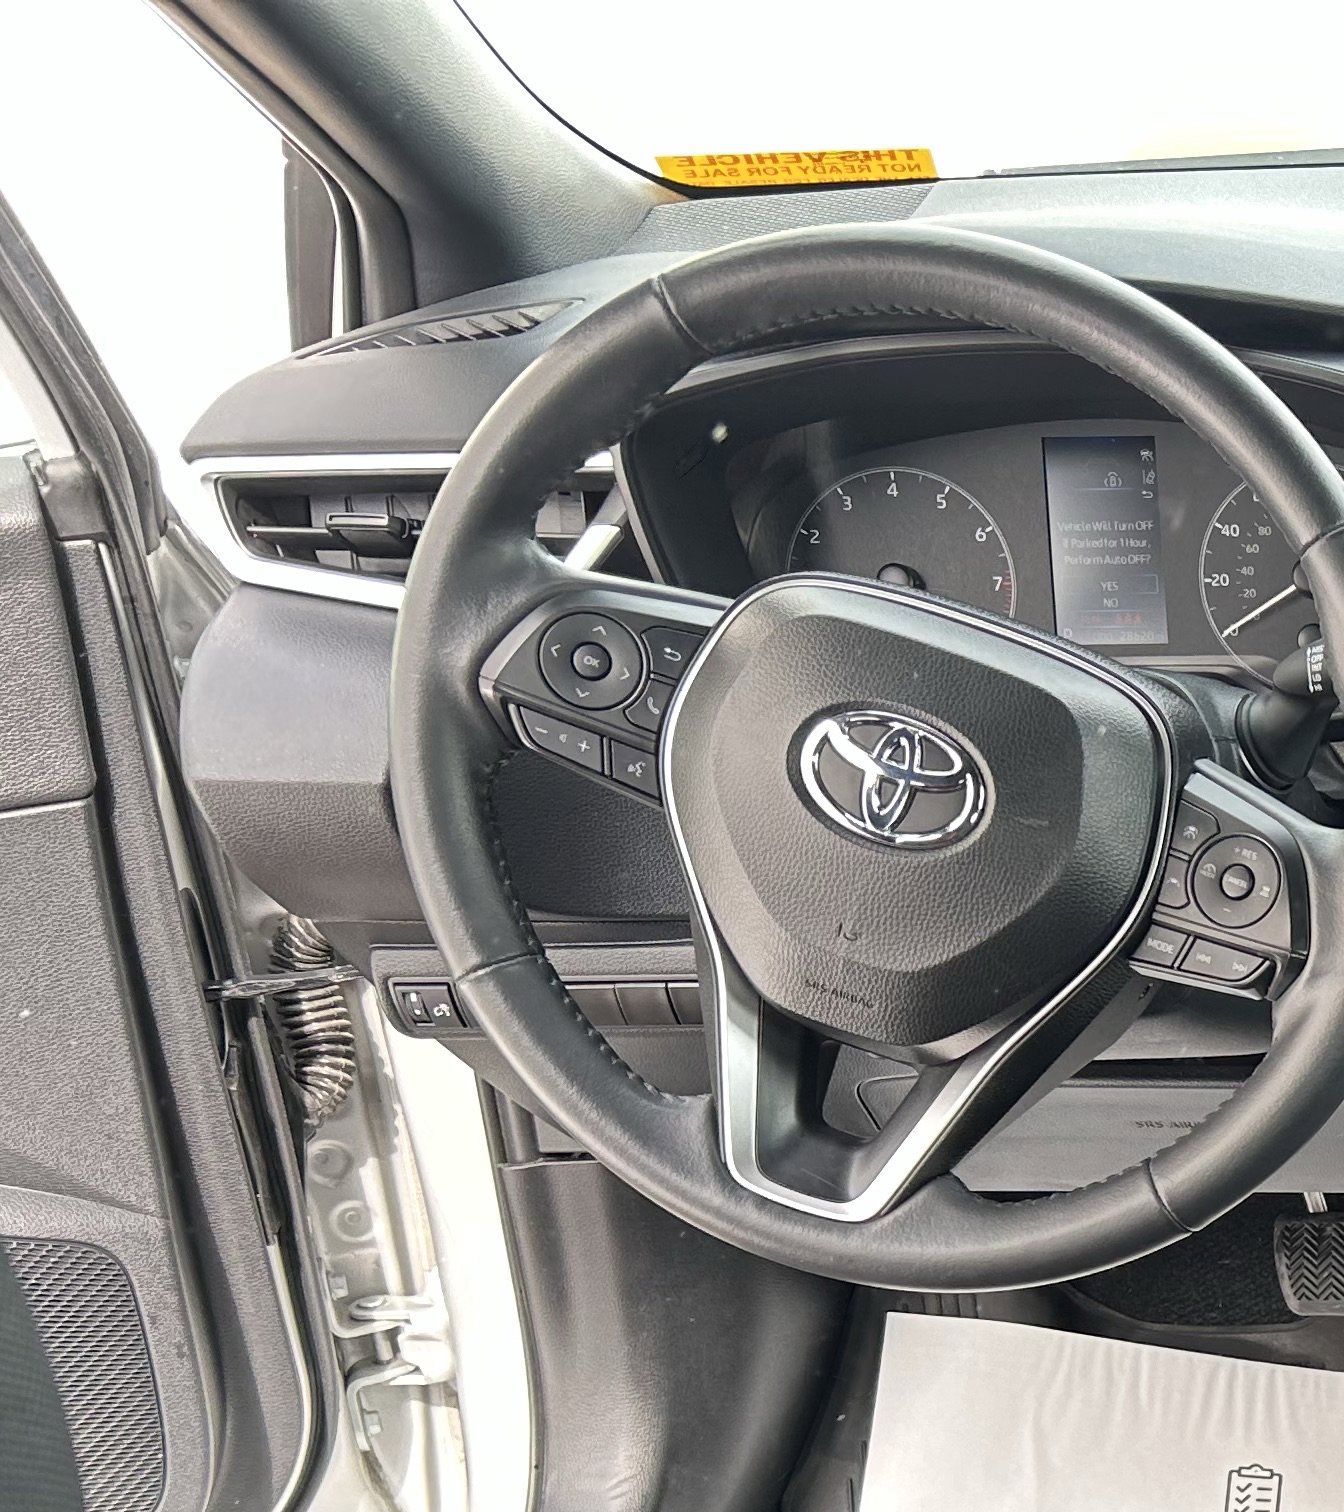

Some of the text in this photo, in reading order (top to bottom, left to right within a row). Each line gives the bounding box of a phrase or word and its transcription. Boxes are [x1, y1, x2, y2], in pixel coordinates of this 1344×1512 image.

[887, 483, 898, 497] 4
[842, 496, 852, 511] 3
[936, 494, 947, 509] 5
[1057, 520, 1154, 531] Vehicle Will Turn OFF
[1220, 524, 1240, 537] 40
[1257, 526, 1272, 536] 80
[809, 529, 820, 544] 2
[975, 527, 987, 542] 6
[1245, 543, 1260, 554] 60
[1064, 554, 1152, 566] Perform Auto OFF?
[1240, 565, 1255, 576] 40
[993, 576, 1003, 591] 7
[1100, 581, 1119, 592] YES
[1211, 574, 1229, 587] 20
[1242, 588, 1257, 598] 20
[1103, 598, 1119, 608] NO
[583, 655, 600, 668] OK
[1311, 653, 1324, 663] OFF
[1146, 937, 1174, 955] MODE
[1135, 1120, 1164, 1129] SRS
